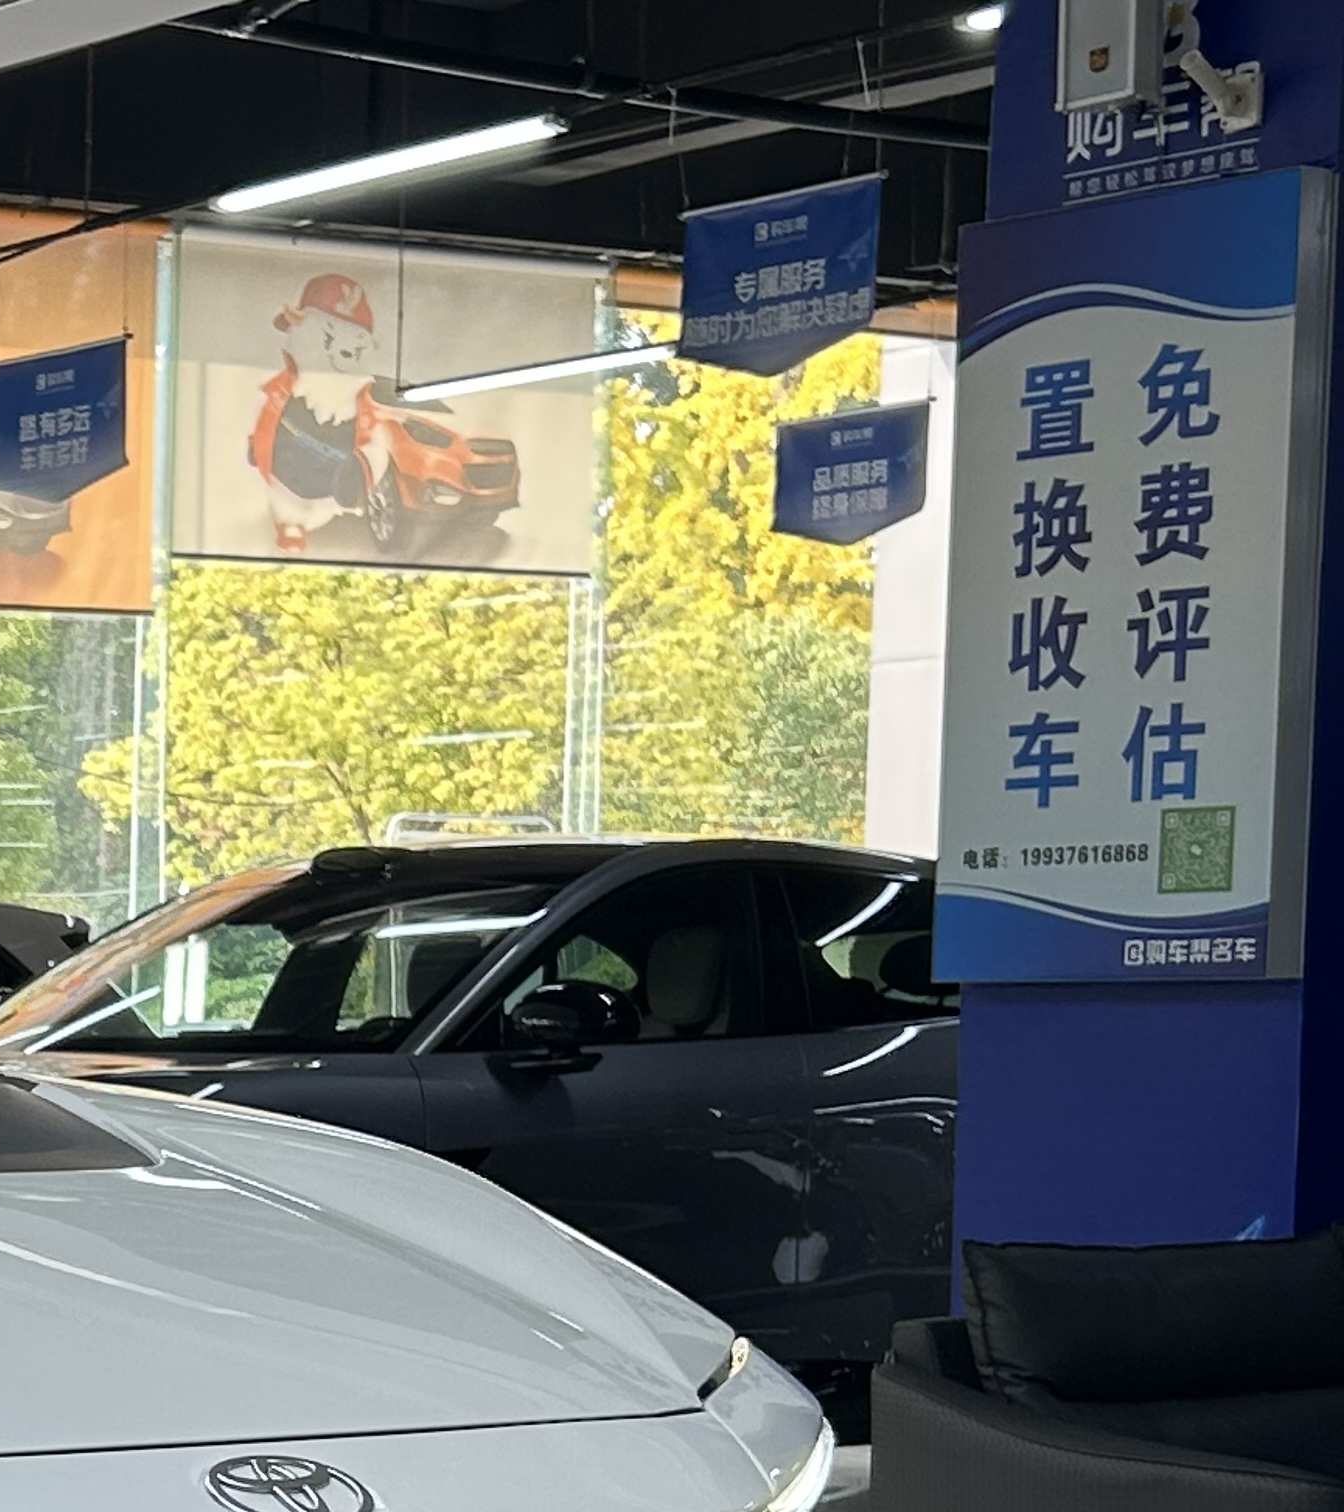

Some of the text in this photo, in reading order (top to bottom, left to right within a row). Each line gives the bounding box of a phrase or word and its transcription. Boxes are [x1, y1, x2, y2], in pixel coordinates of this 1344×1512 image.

[733, 258, 828, 302] 专属服务
[1004, 357, 1095, 809] 置换收车
[1122, 343, 1221, 803] 免费评估
[1020, 843, 1150, 867] 19937616868
